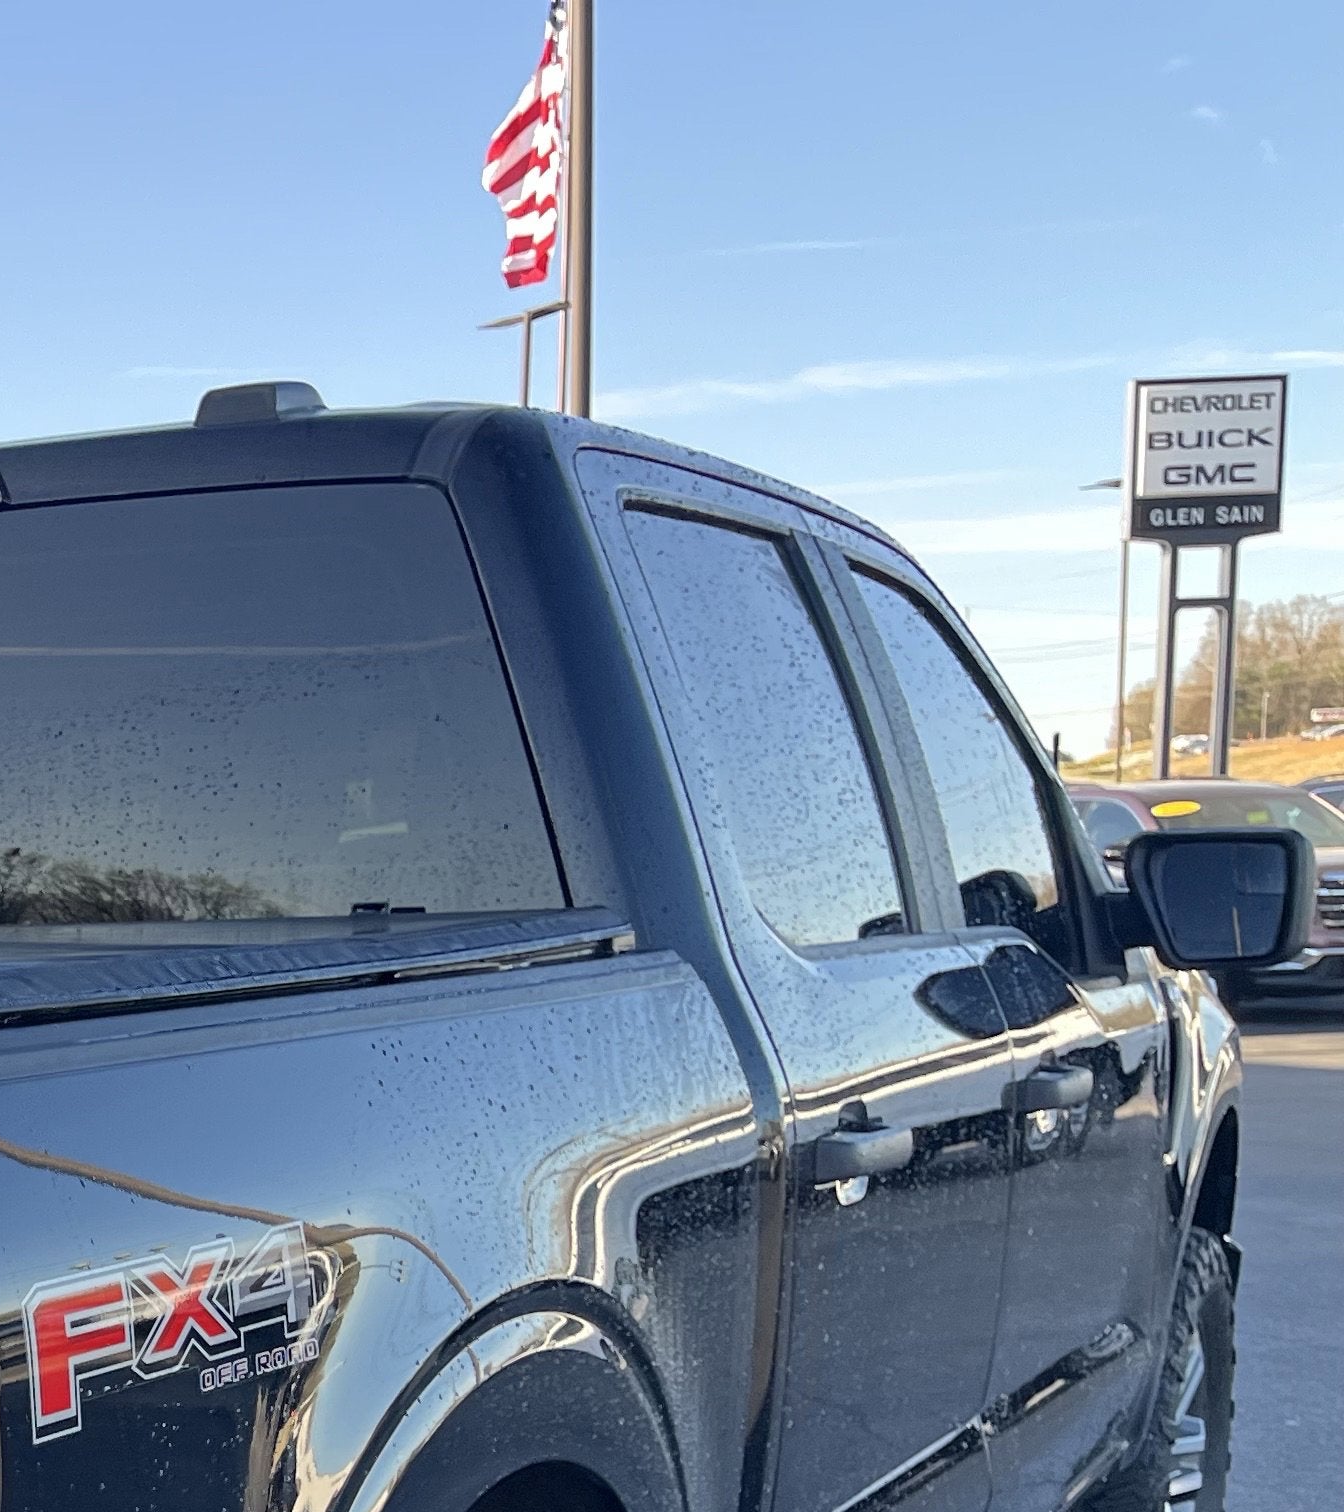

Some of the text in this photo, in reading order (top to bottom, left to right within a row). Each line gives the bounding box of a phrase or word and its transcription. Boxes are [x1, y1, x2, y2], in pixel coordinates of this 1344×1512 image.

[1149, 391, 1276, 415] CHEVROLET
[1148, 427, 1274, 450] BUICK
[1163, 462, 1257, 486] GMC
[1149, 505, 1265, 527] GLEN SAIN
[21, 1220, 319, 1445] FX4
